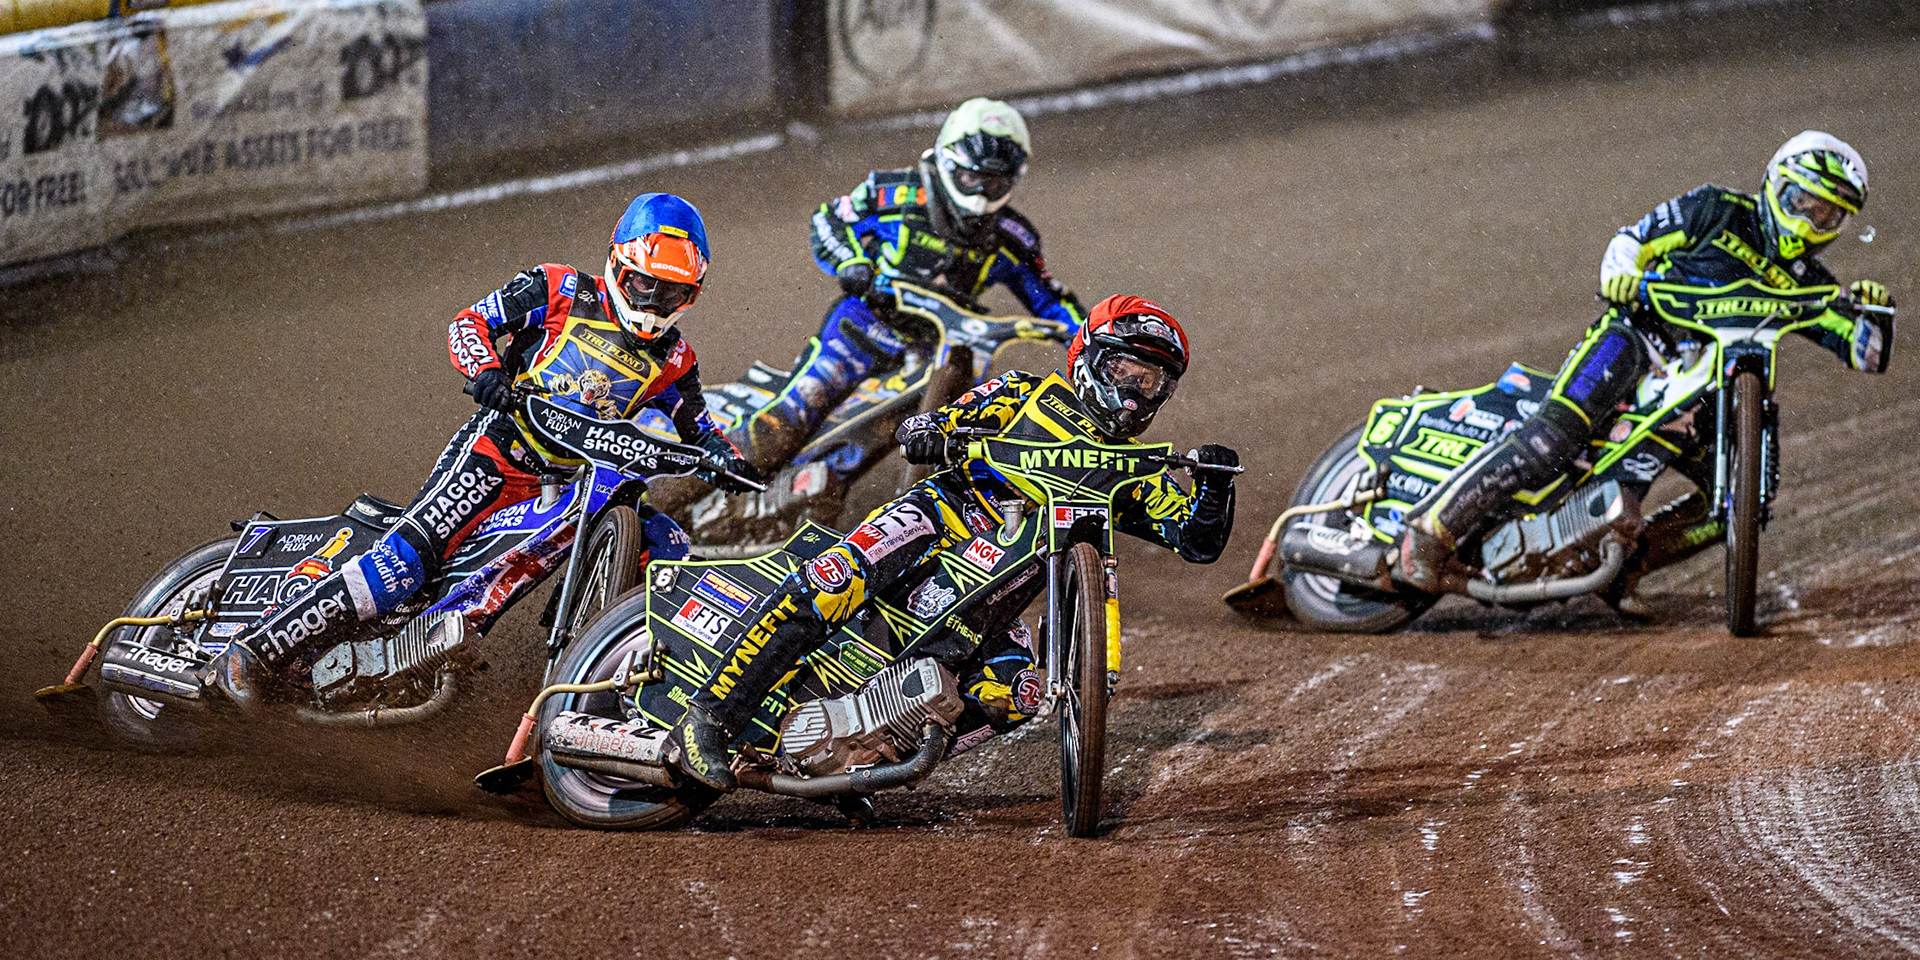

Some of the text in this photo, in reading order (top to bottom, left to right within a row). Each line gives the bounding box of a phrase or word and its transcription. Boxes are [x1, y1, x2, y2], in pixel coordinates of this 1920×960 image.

[606, 344, 641, 370] PLANT
[541, 407, 582, 430] ADRIAN
[1049, 397, 1075, 418] TRU
[545, 419, 571, 436] FLUX
[1368, 411, 1404, 444] 6
[582, 438, 659, 471] SHOCKS
[585, 426, 662, 459] HAGON
[1019, 448, 1141, 474] MYNEFIT
[435, 473, 503, 541] SHOCKS
[240, 527, 271, 554] 7
[276, 533, 324, 545] ADRIAN
[281, 541, 310, 552] FLUX
[969, 539, 1004, 565] NGK
[867, 546, 884, 560] Fire
[371, 550, 400, 593] Judith
[656, 567, 673, 583] 6
[815, 557, 845, 583] STS
[691, 605, 729, 635] FTS
[709, 593, 799, 700] MYNEFIT
[565, 724, 636, 754] Campers
